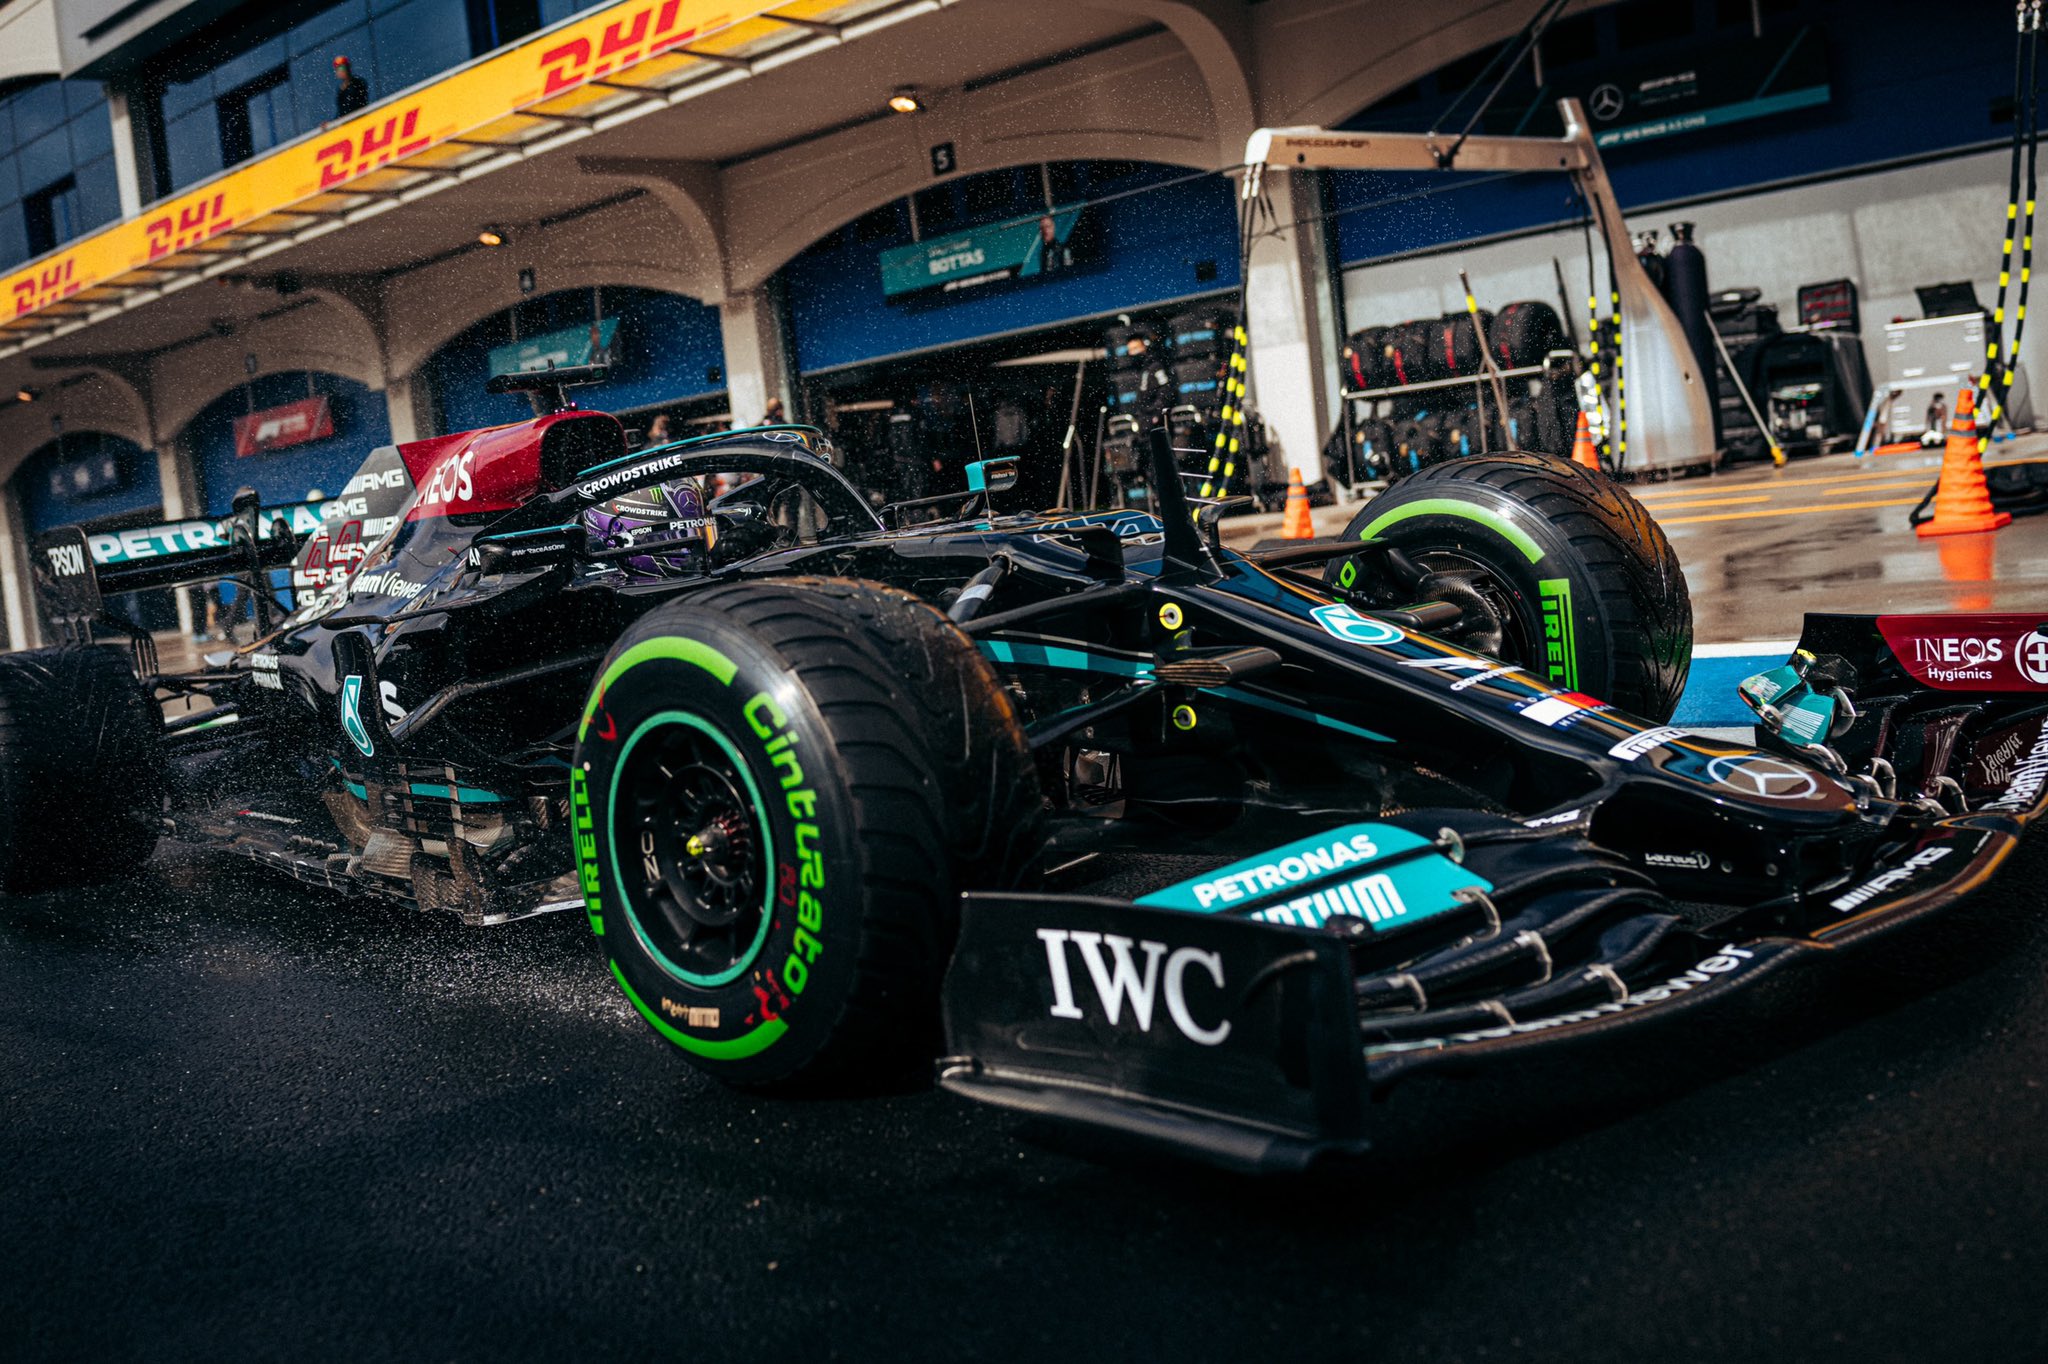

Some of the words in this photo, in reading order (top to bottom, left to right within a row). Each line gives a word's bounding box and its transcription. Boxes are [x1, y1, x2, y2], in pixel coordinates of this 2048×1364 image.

[540, 0, 696, 95] DHL
[314, 107, 432, 188] DHL
[143, 193, 234, 260] DHL
[12, 258, 81, 314] DHL
[360, 469, 405, 493] AMG
[583, 454, 683, 494] CROWDSTRIKE
[88, 500, 332, 564] PETRNA
[615, 504, 668, 518] CROWDSTRIKE
[631, 526, 653, 536] EPSON
[669, 516, 716, 531] PETRONAS
[1539, 578, 1579, 693] PIREL
[1915, 637, 2003, 663] INEOS
[1927, 667, 1993, 683] Hygienics
[570, 766, 605, 936] PIRELLI
[743, 692, 827, 994] Cinturato
[1193, 834, 1378, 908] PETRONAS
[1037, 928, 1232, 1046] IWC
